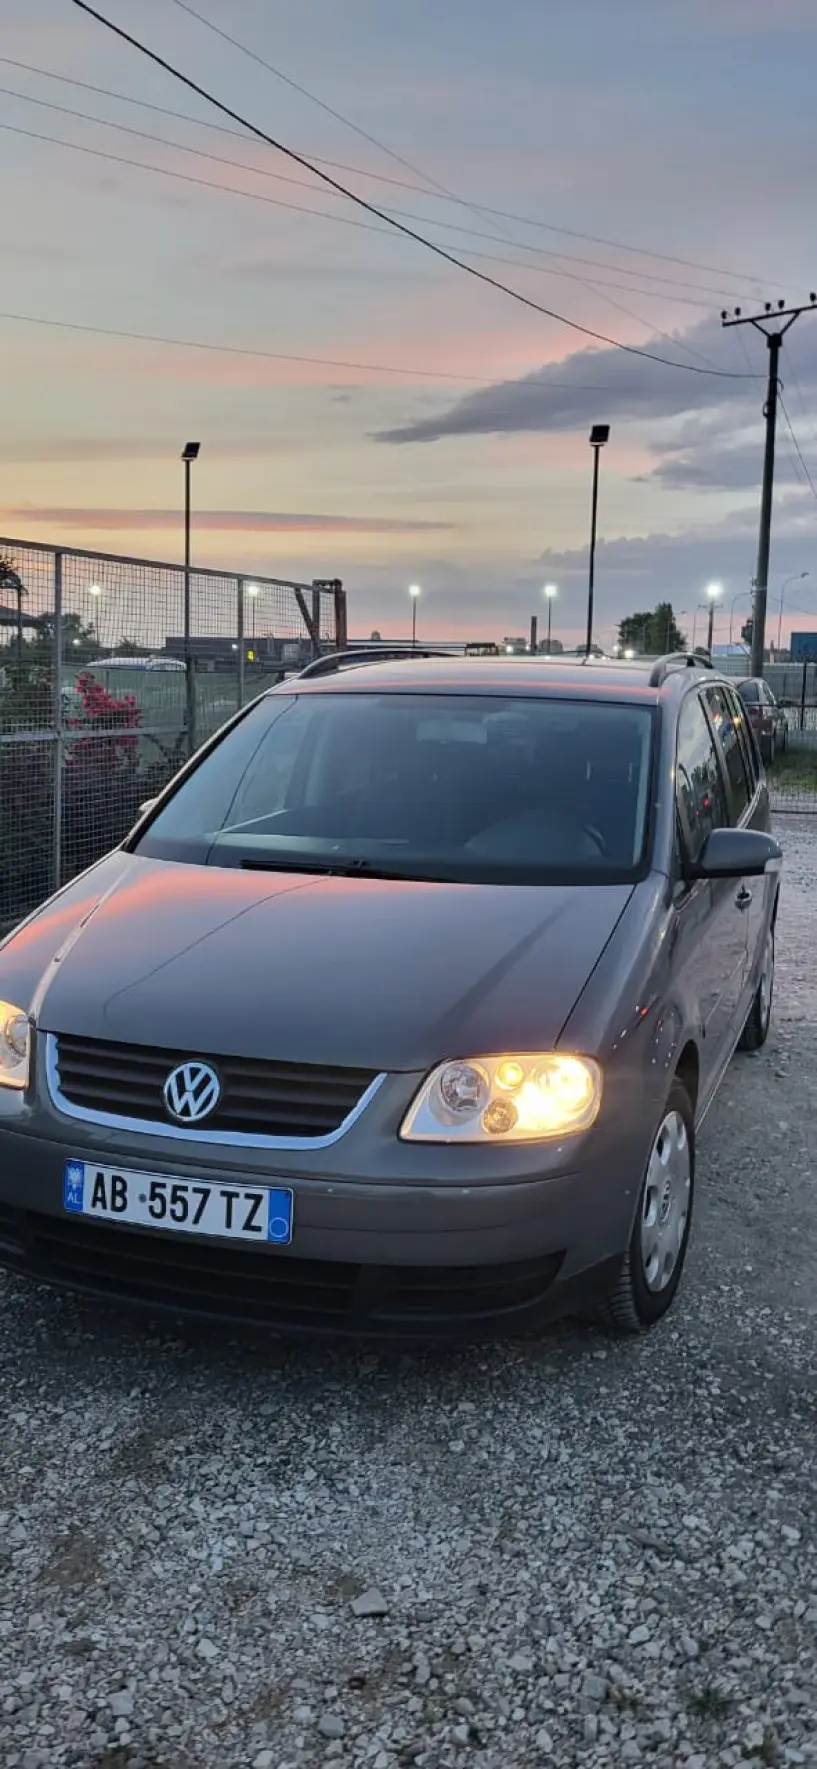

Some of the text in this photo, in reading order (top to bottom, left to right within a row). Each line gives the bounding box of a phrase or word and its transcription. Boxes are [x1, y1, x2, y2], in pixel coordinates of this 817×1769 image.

[91, 1172, 264, 1233] AB 557 TZ
